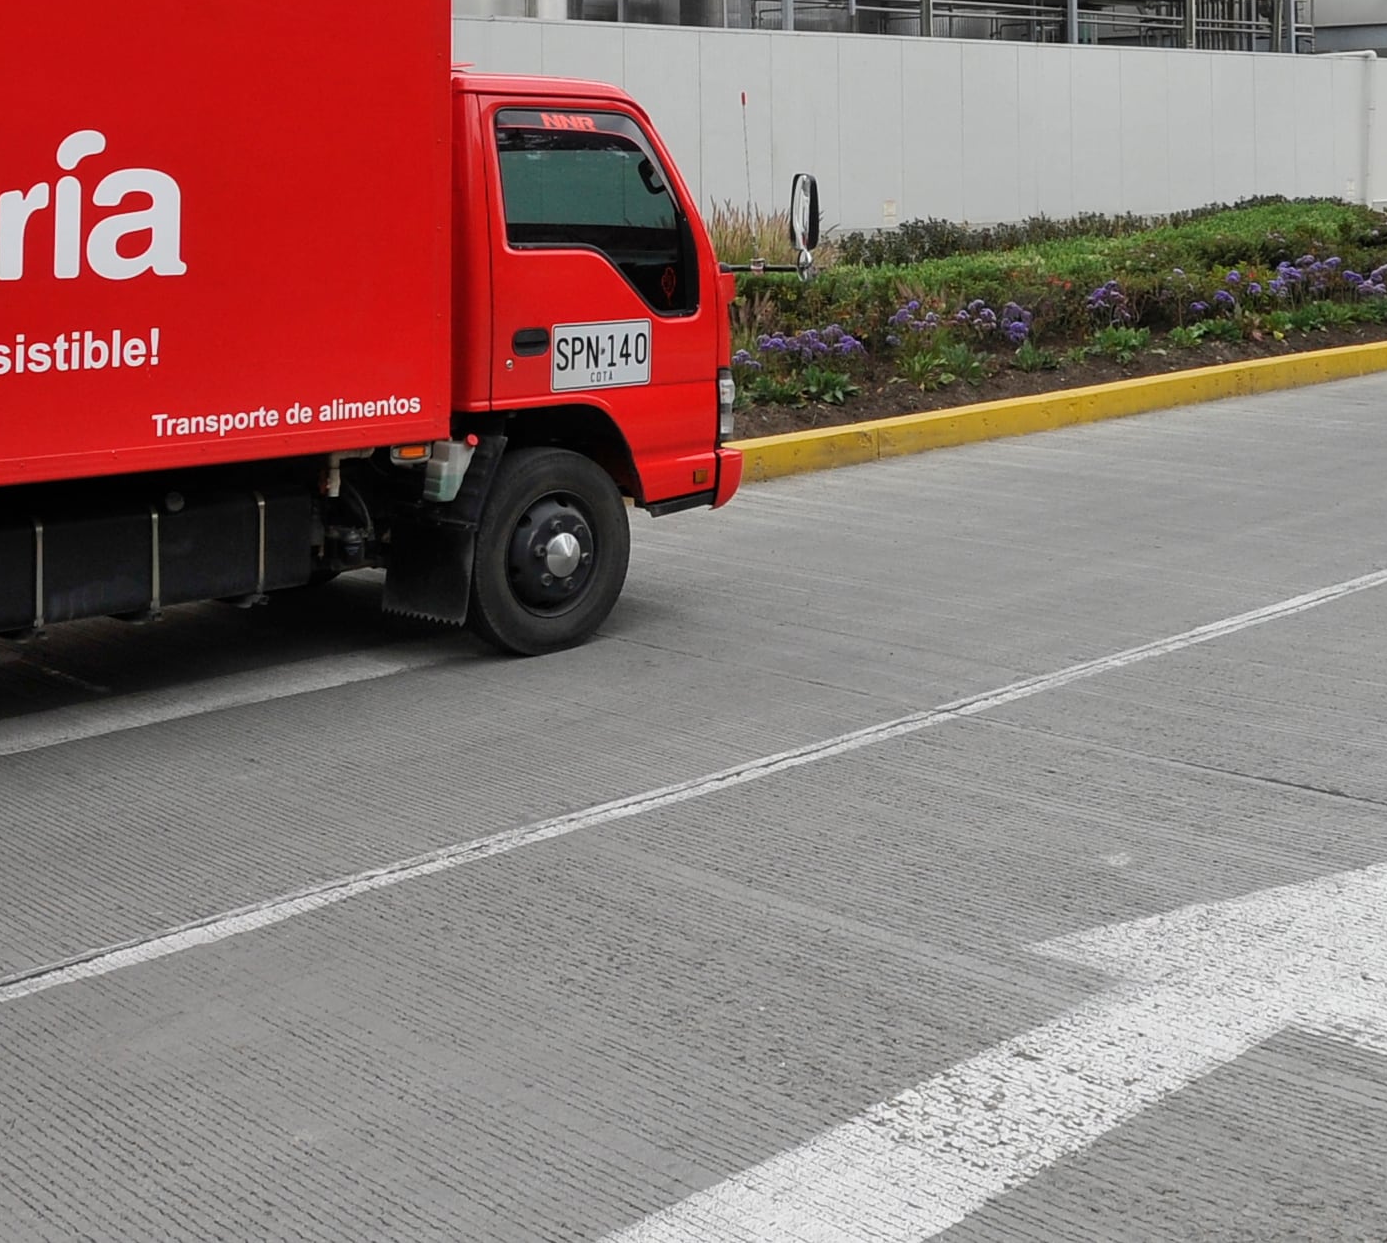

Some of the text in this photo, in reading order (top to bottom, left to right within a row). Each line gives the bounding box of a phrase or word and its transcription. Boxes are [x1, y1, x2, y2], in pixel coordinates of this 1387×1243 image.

[590, 370, 613, 382] COTA
[151, 396, 421, 439] Transporte de alimentos
